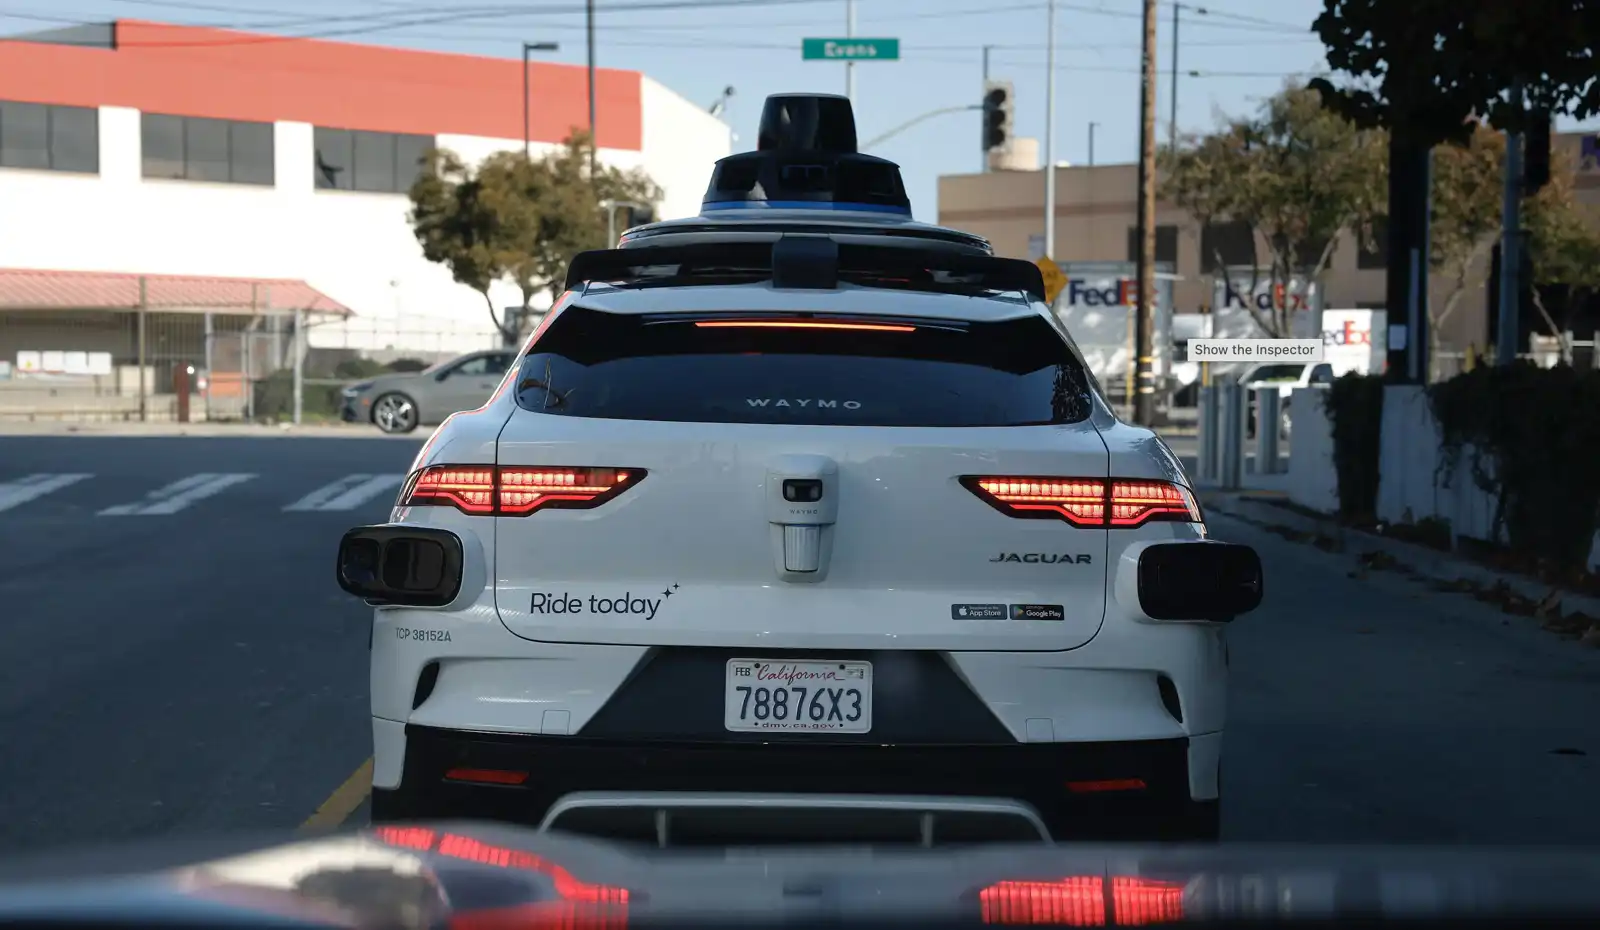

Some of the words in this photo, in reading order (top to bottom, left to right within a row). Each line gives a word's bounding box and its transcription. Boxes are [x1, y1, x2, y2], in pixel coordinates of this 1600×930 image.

[824, 42, 877, 57] Evans
[1069, 278, 1157, 306] FedE
[1321, 320, 1372, 346] edEx
[746, 398, 861, 410] WAYMO
[989, 552, 1092, 564] JAGUAR
[530, 592, 583, 615] Ride
[589, 592, 662, 621] today
[1026, 610, 1048, 618] Google
[1049, 610, 1062, 618] Play
[395, 627, 411, 640] TCP
[412, 629, 452, 642] 38152A
[735, 667, 751, 677] FEB
[757, 663, 845, 686] California
[736, 686, 862, 722] 78876X3
[761, 722, 836, 730] dmv.ca.gov
